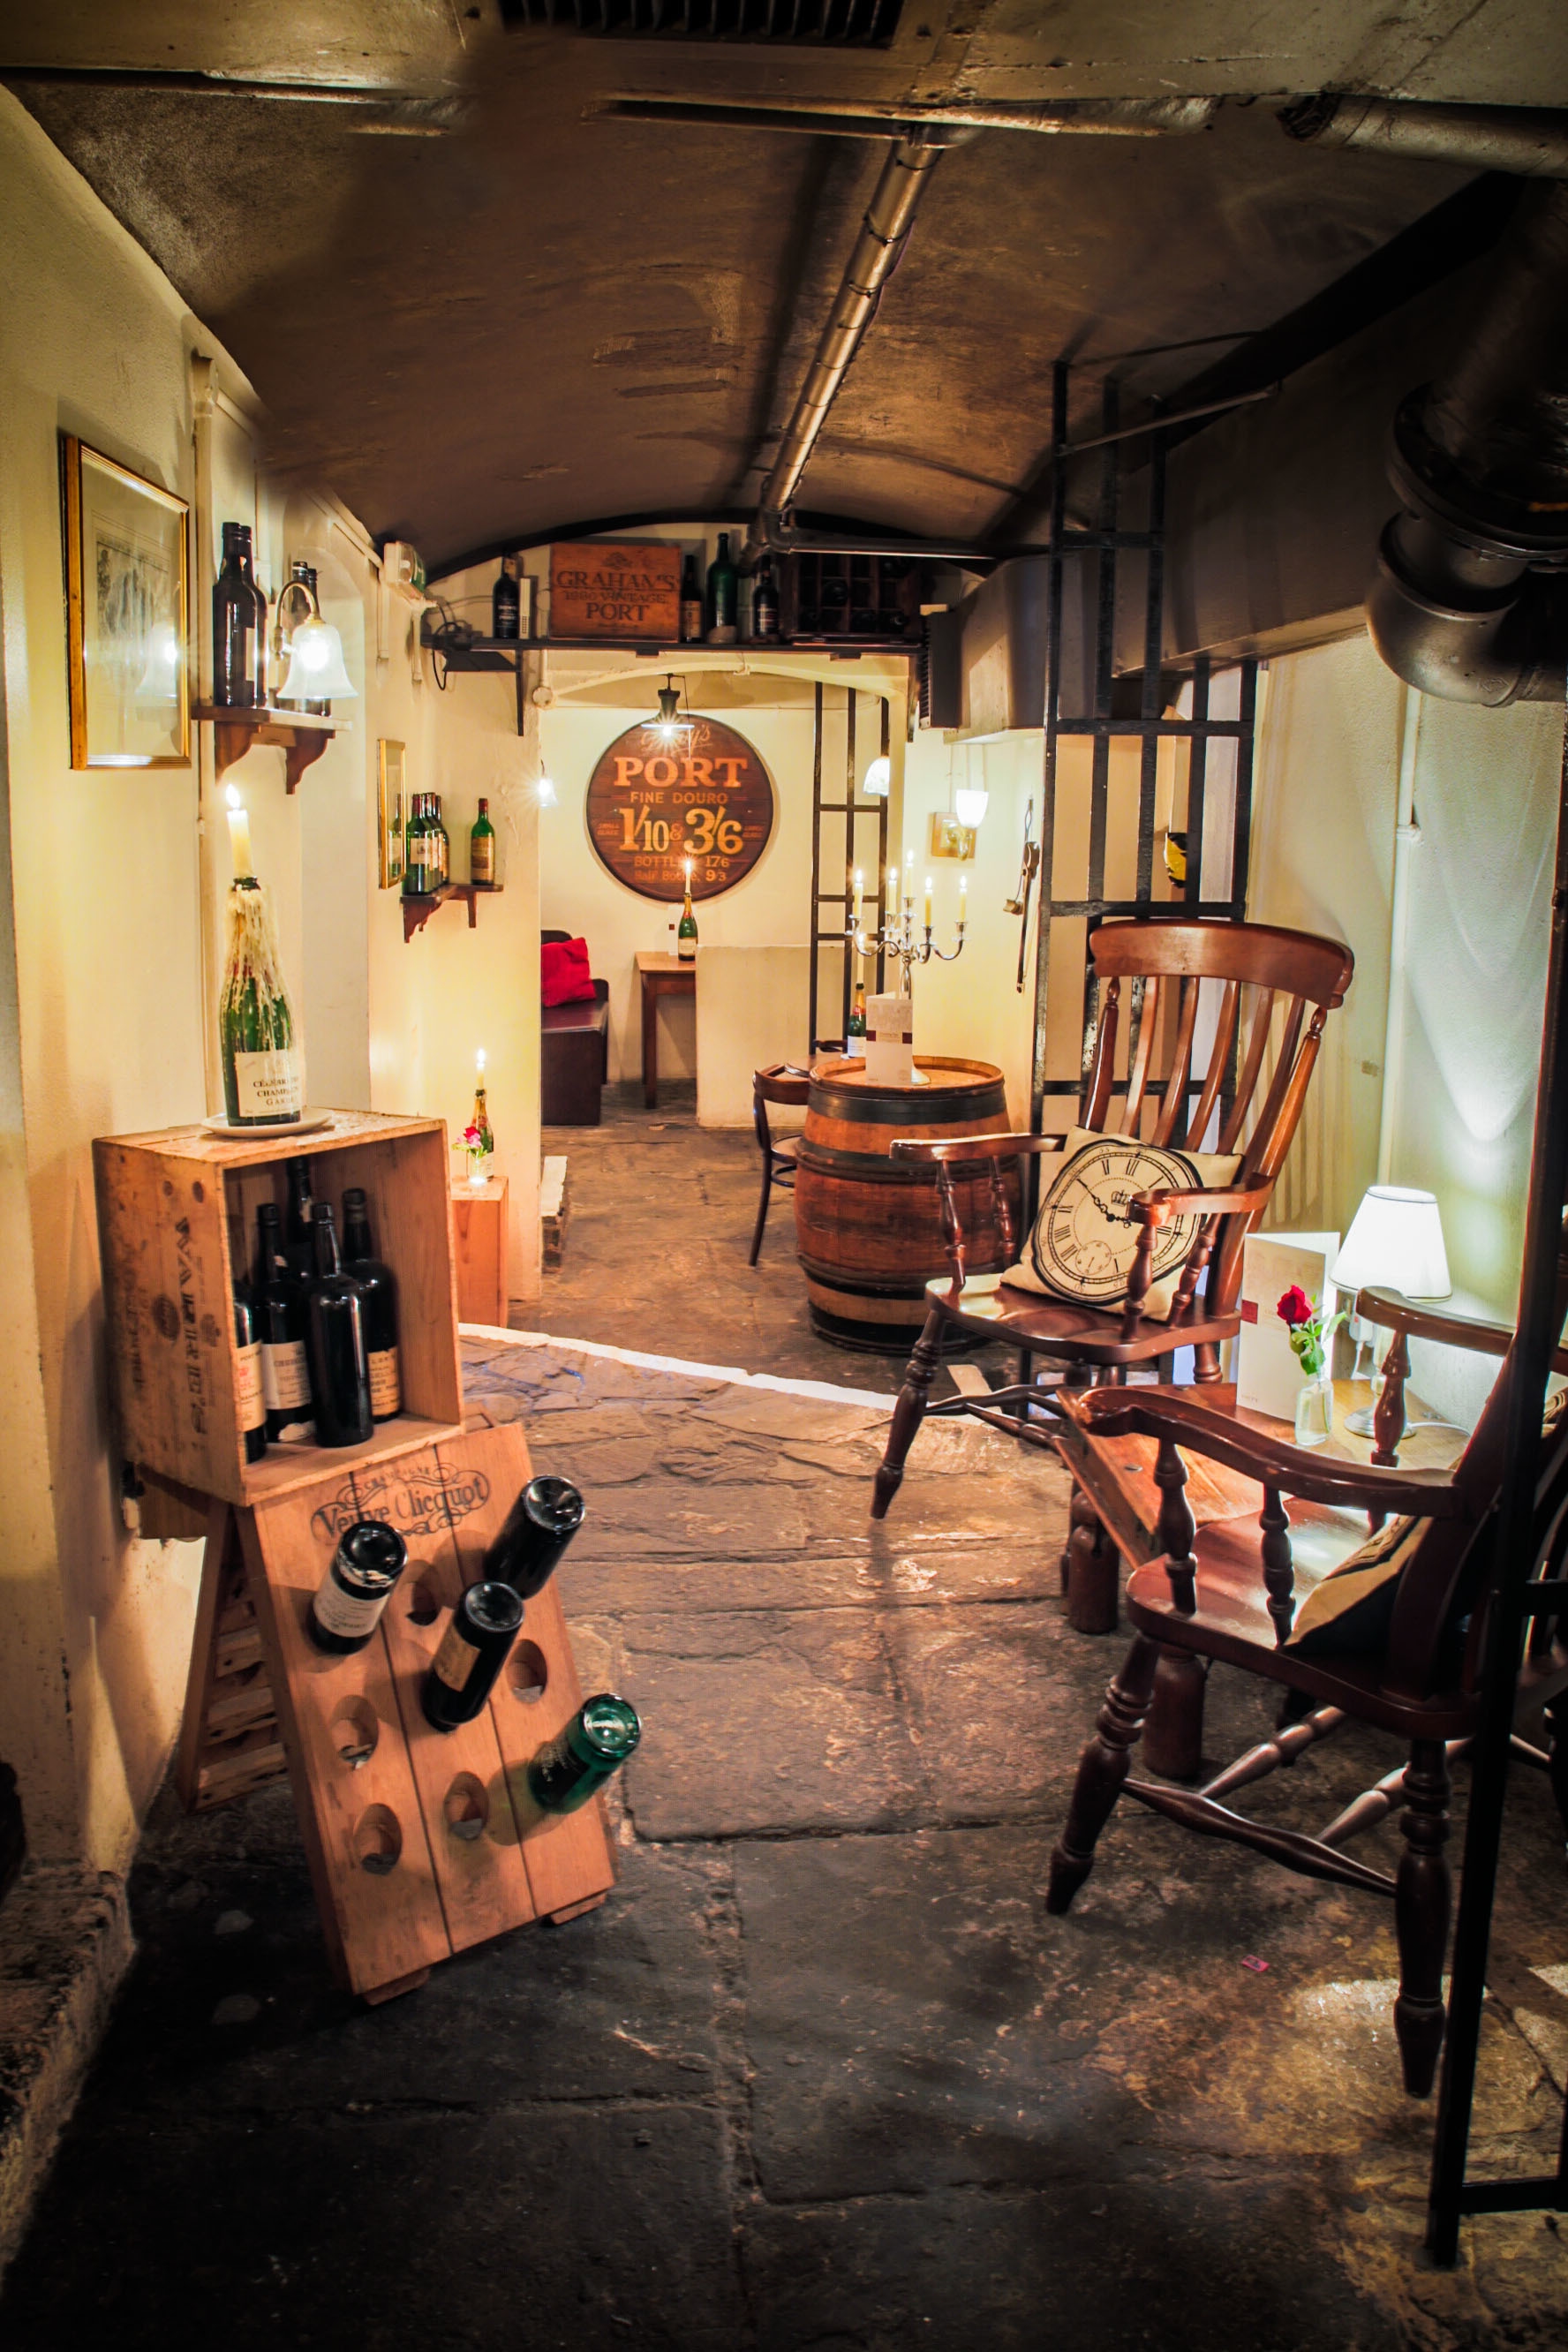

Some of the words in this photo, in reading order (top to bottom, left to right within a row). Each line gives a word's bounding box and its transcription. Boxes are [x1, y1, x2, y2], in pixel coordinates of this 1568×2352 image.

[556, 570, 677, 590] GRAHAM'S
[585, 602, 650, 622] PORT
[614, 757, 748, 788] PORT
[629, 791, 665, 804] FINE
[672, 792, 728, 804] DOURO
[395, 1477, 486, 1521] Clicquot
